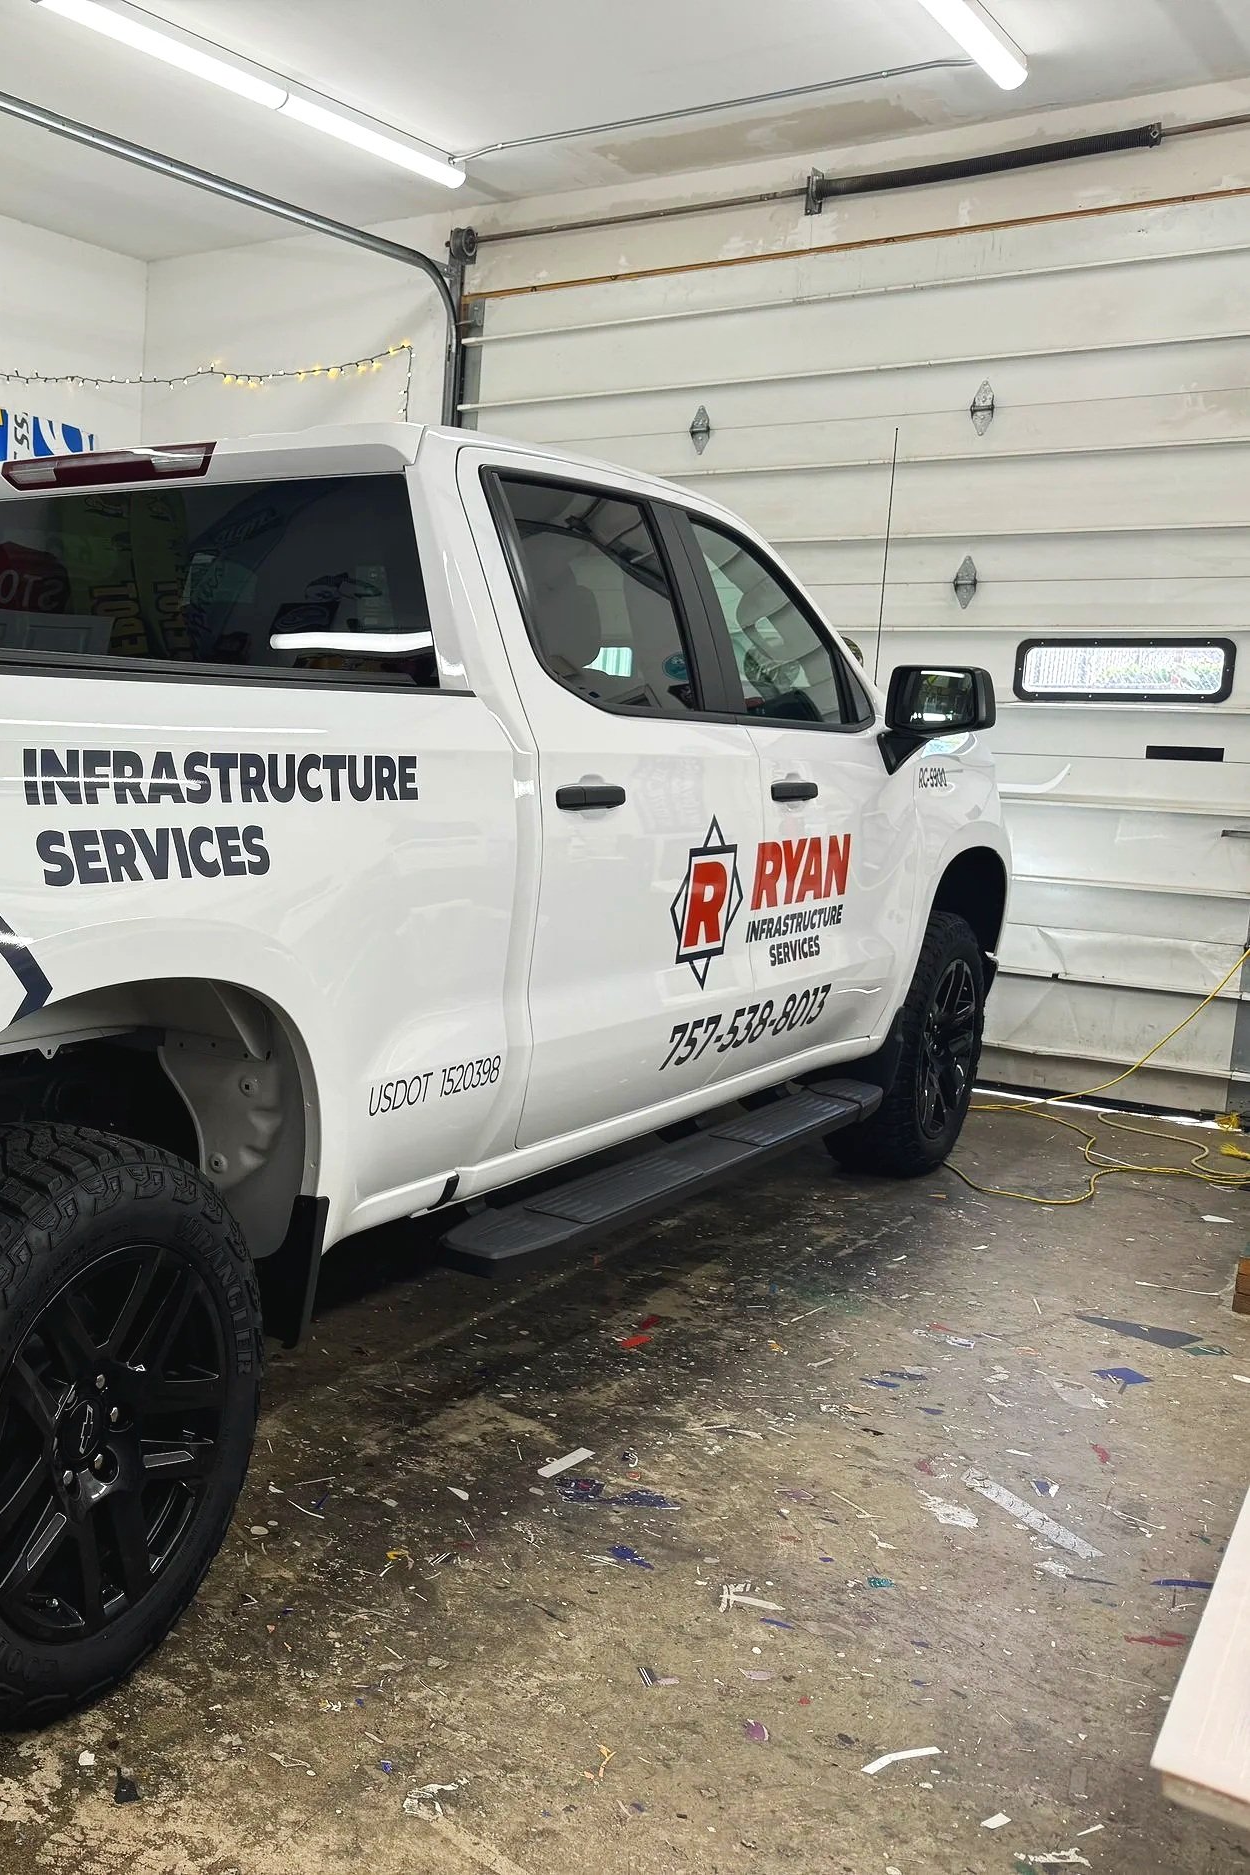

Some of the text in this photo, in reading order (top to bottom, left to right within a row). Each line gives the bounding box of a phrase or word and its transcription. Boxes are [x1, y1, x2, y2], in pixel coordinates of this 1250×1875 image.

[22, 748, 419, 806] INFRASTRUCTURE
[918, 767, 948, 789] RC-5900
[35, 824, 271, 888] SERVICES
[750, 833, 852, 911] RYAN
[683, 860, 728, 948] R
[745, 904, 843, 944] INFRASTRUCTURE
[769, 935, 821, 967] SERVICES
[658, 983, 832, 1071] 757-538-8013
[368, 1055, 502, 1117] USDOT 1520398
